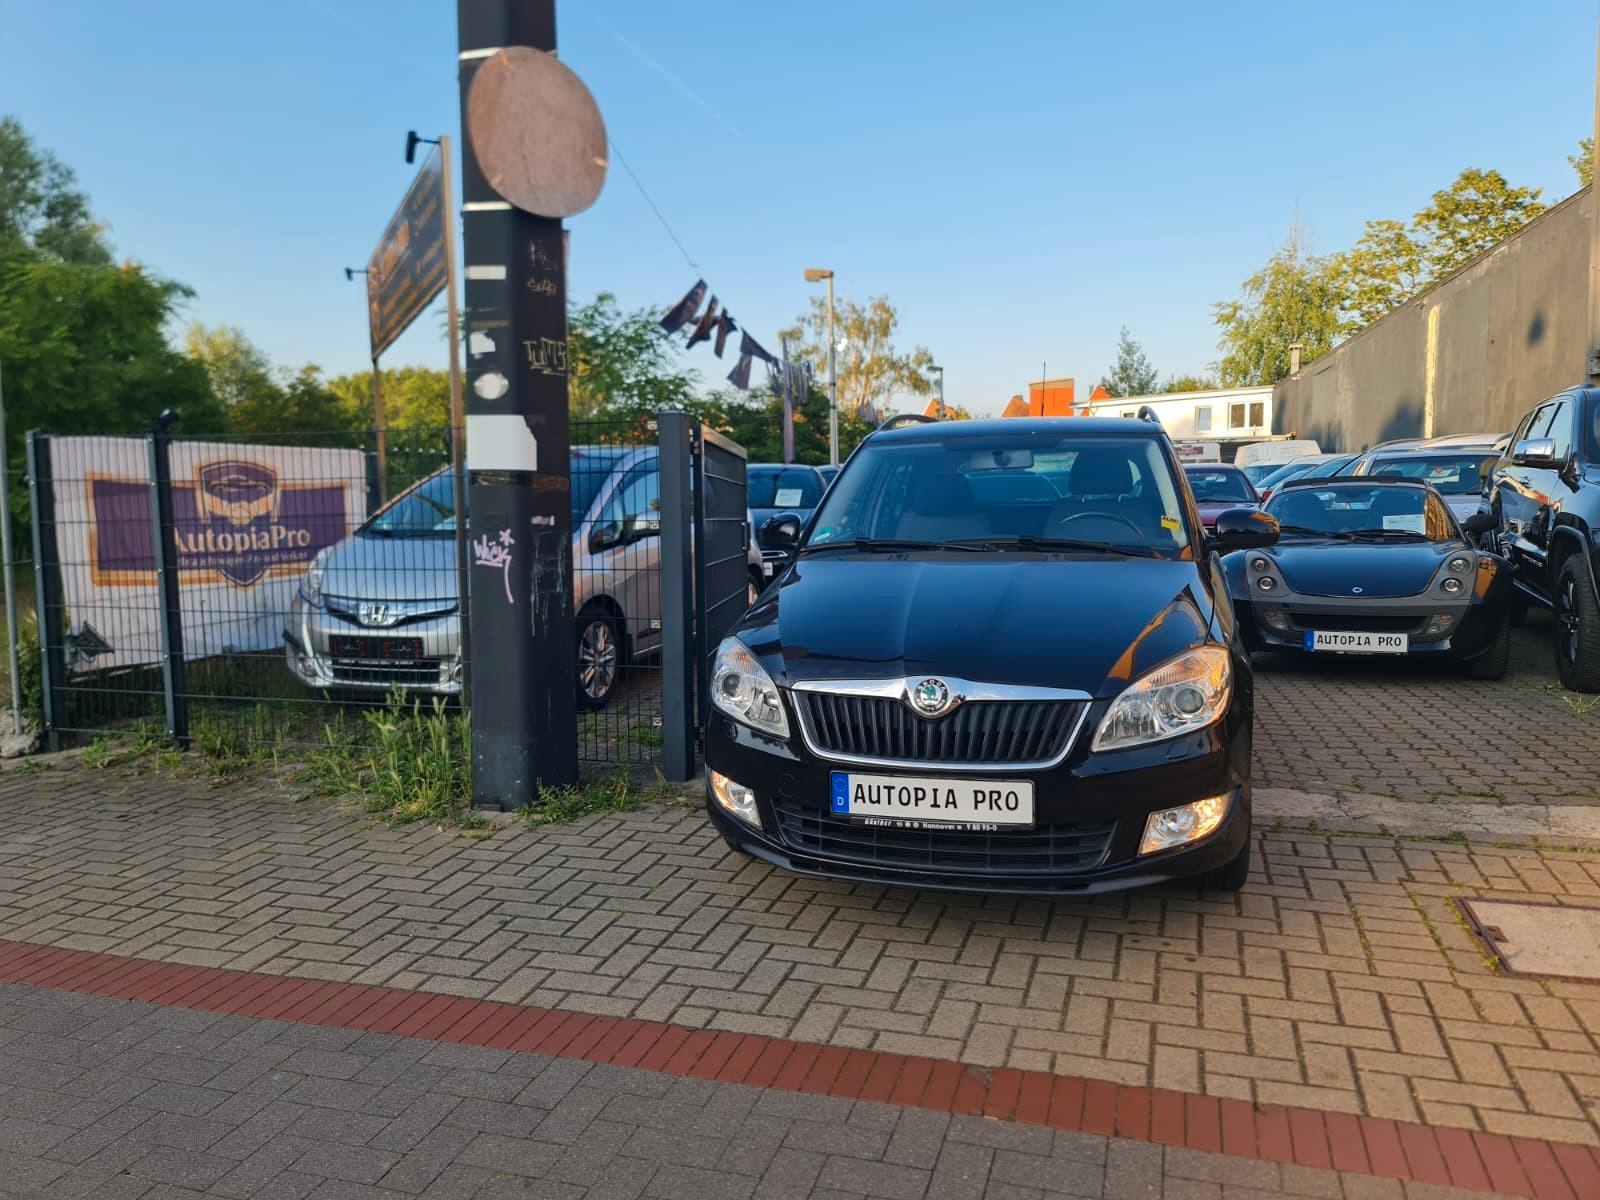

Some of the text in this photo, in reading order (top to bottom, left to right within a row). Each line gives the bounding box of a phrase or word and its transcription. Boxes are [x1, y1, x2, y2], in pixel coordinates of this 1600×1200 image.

[1317, 634, 1371, 646] AUTOPIA
[1378, 636, 1402, 647] PRO
[837, 796, 844, 806] D
[853, 784, 1019, 811] AUTOPIA PRO
